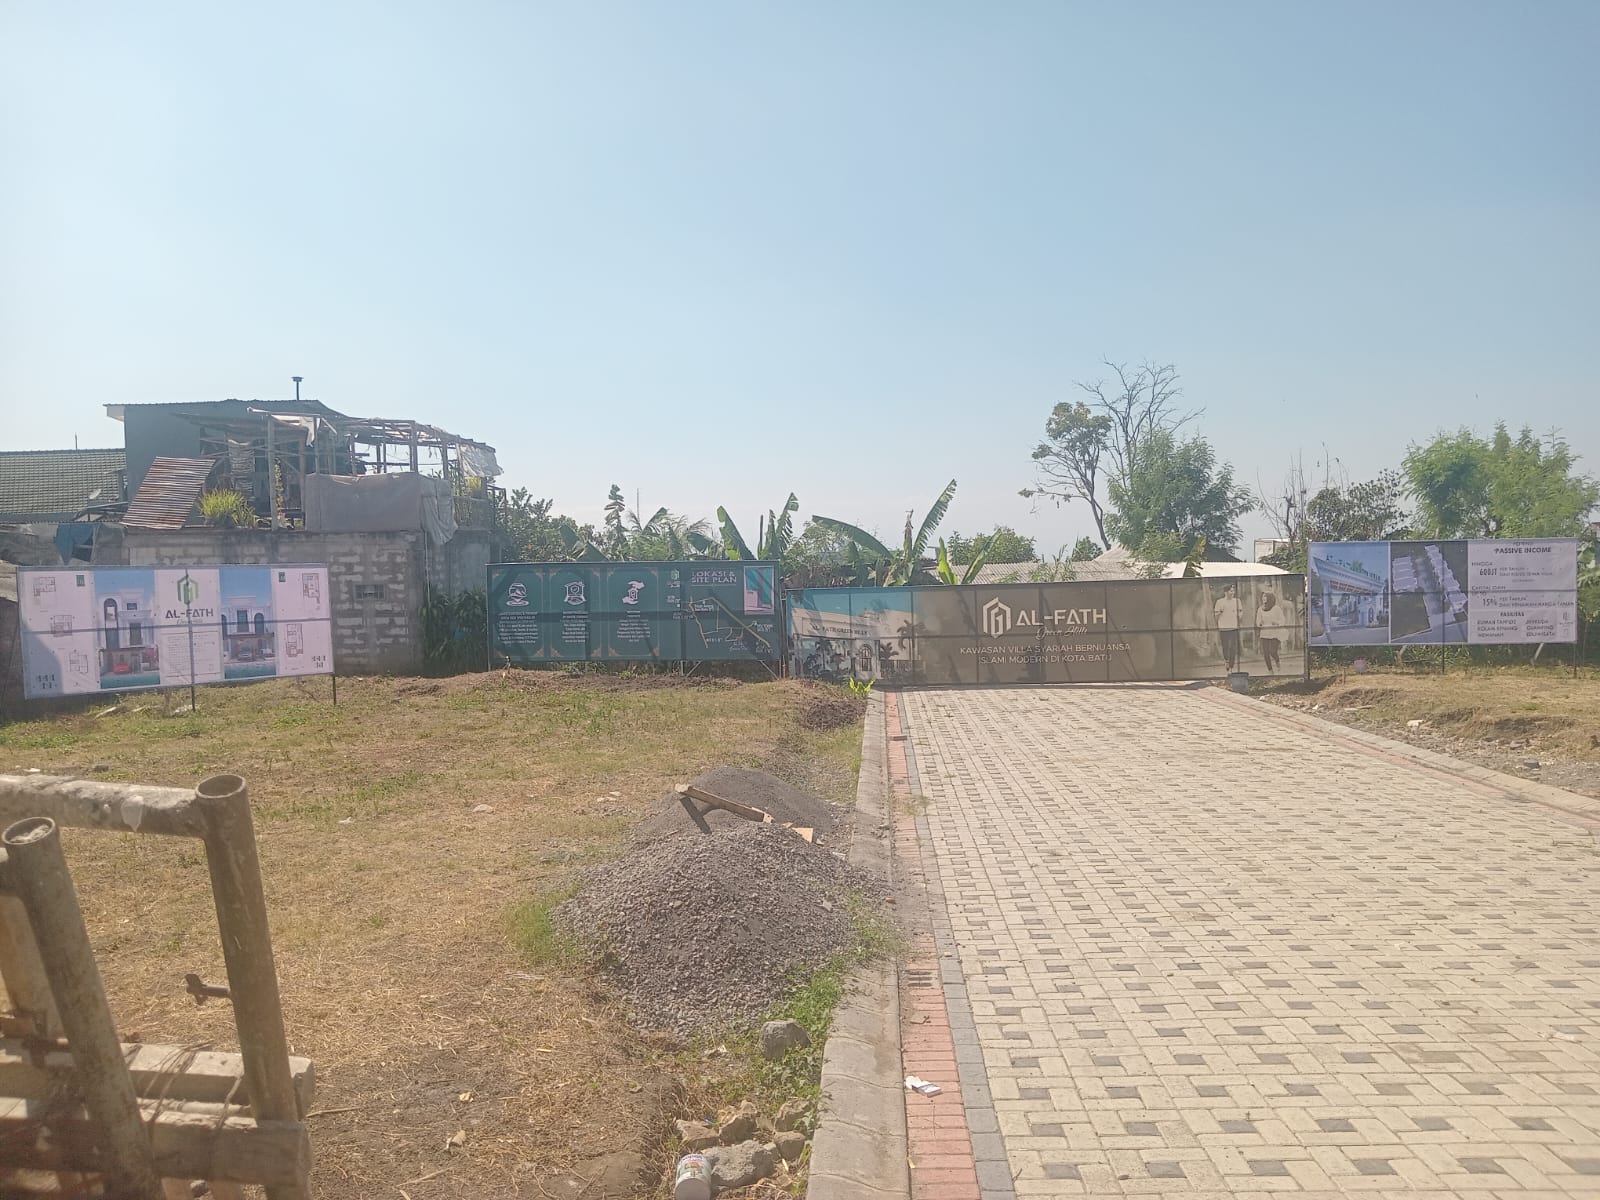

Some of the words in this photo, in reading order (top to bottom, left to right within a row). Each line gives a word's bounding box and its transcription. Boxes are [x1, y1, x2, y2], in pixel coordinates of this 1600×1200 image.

[165, 608, 214, 619] AL-FATH
[1015, 608, 1107, 626] AL-FATH
[960, 646, 1006, 655] KAWASAN
[1007, 645, 1033, 654] VILLA
[1034, 644, 1073, 653] SYARIAH
[1075, 643, 1132, 652] BERNUANSA
[979, 656, 1007, 665] ISLAMI
[1008, 655, 1049, 664] MODERN
[1050, 655, 1061, 663] DI
[1062, 655, 1086, 663] KOTA
[1088, 654, 1112, 662] BATU
